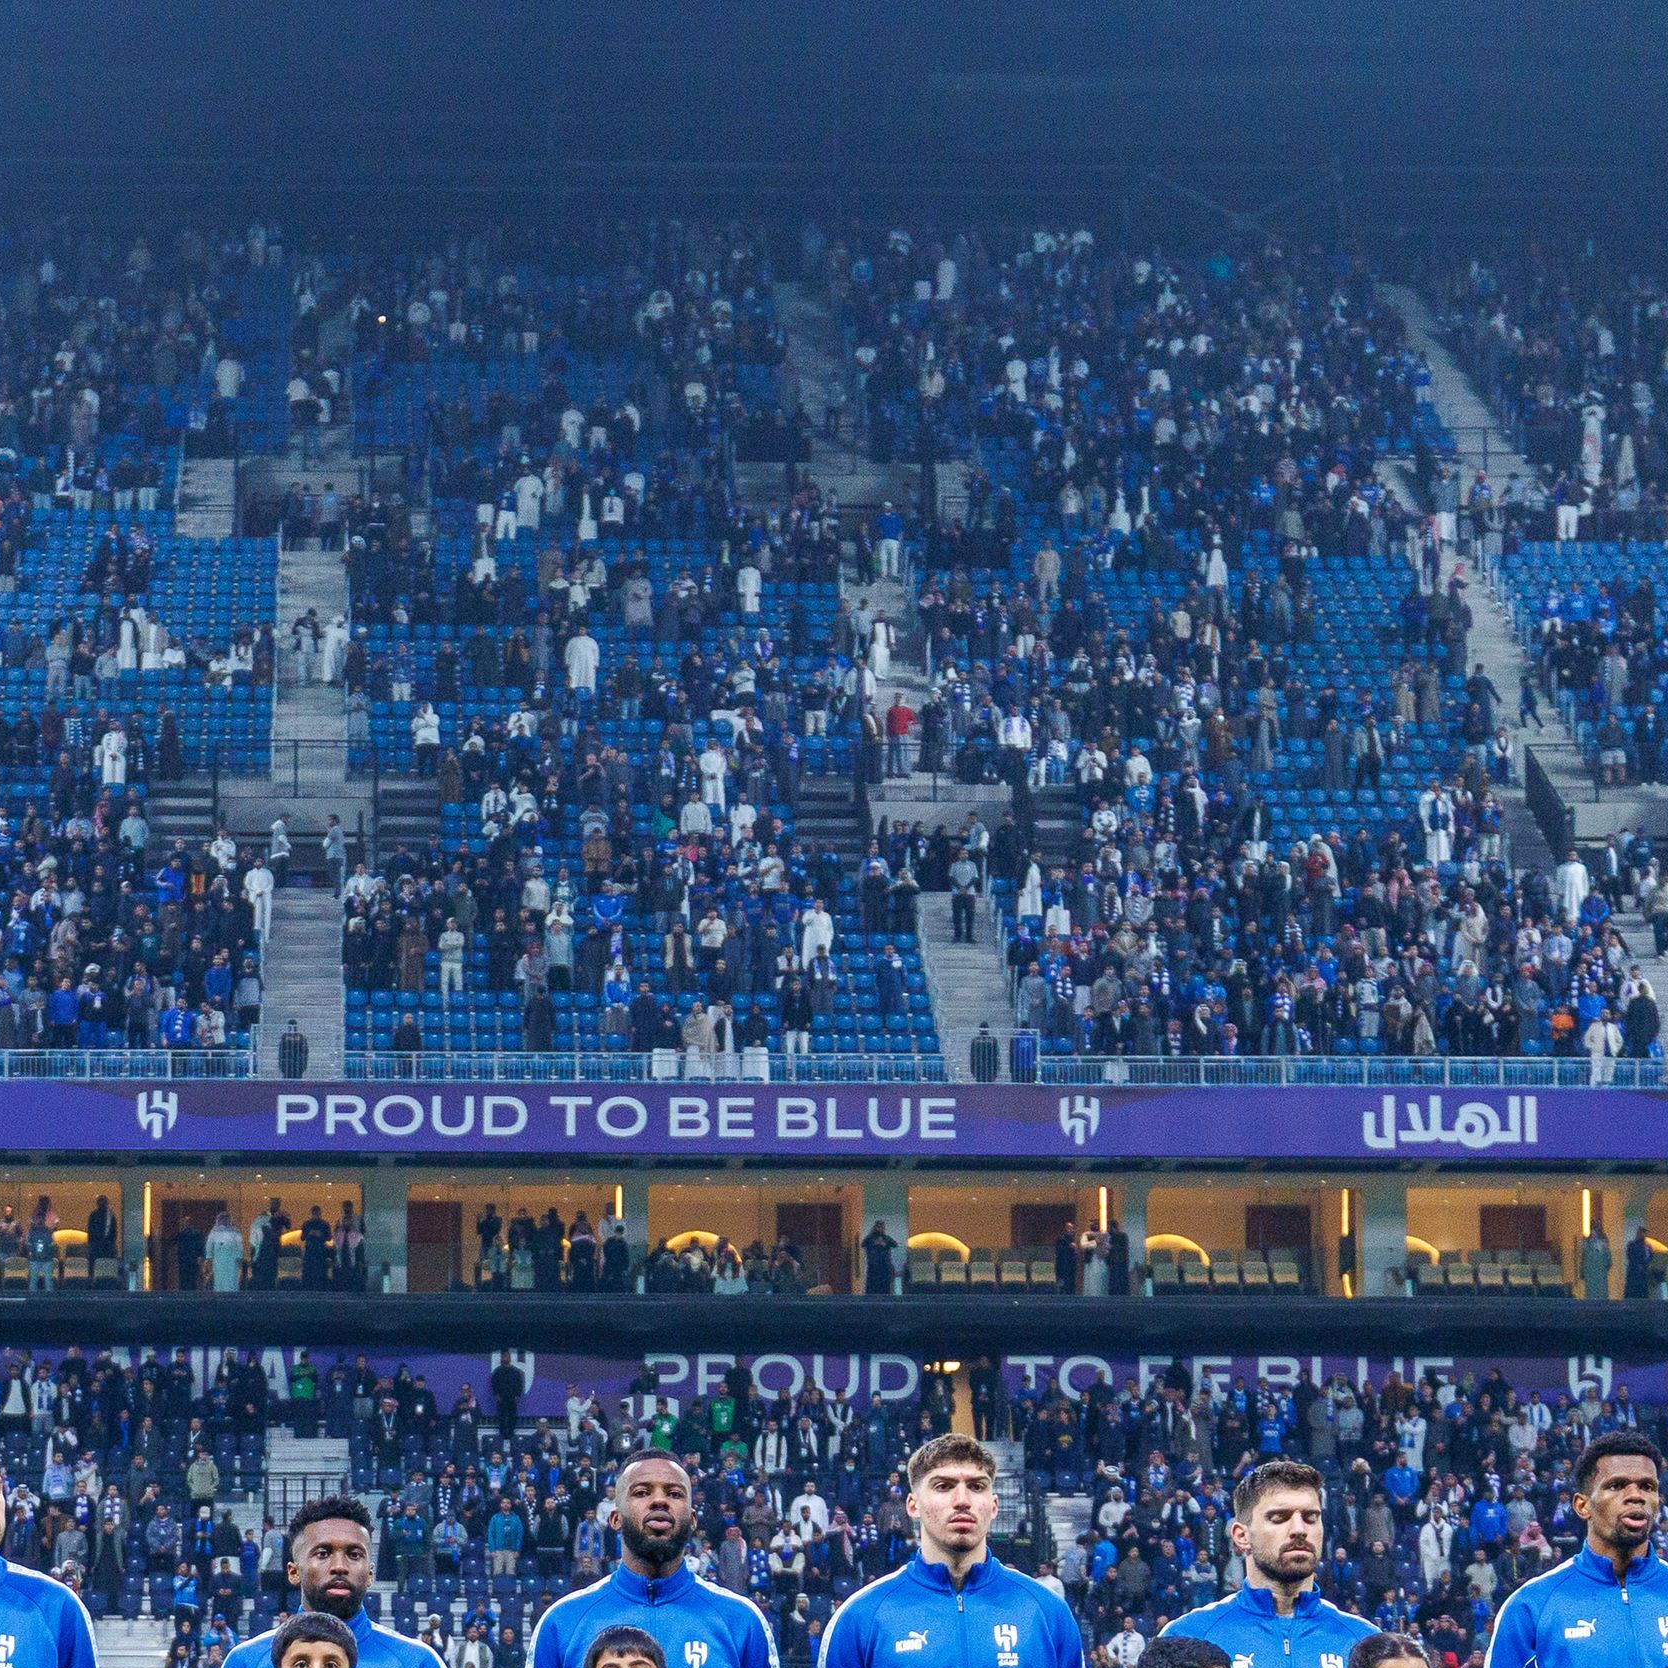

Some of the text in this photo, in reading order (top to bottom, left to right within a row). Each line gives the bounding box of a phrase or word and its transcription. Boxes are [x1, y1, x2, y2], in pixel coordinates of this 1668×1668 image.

[275, 1093, 959, 1141] PROUD TO BE BLUE
[1361, 1093, 1540, 1150] الهلال
